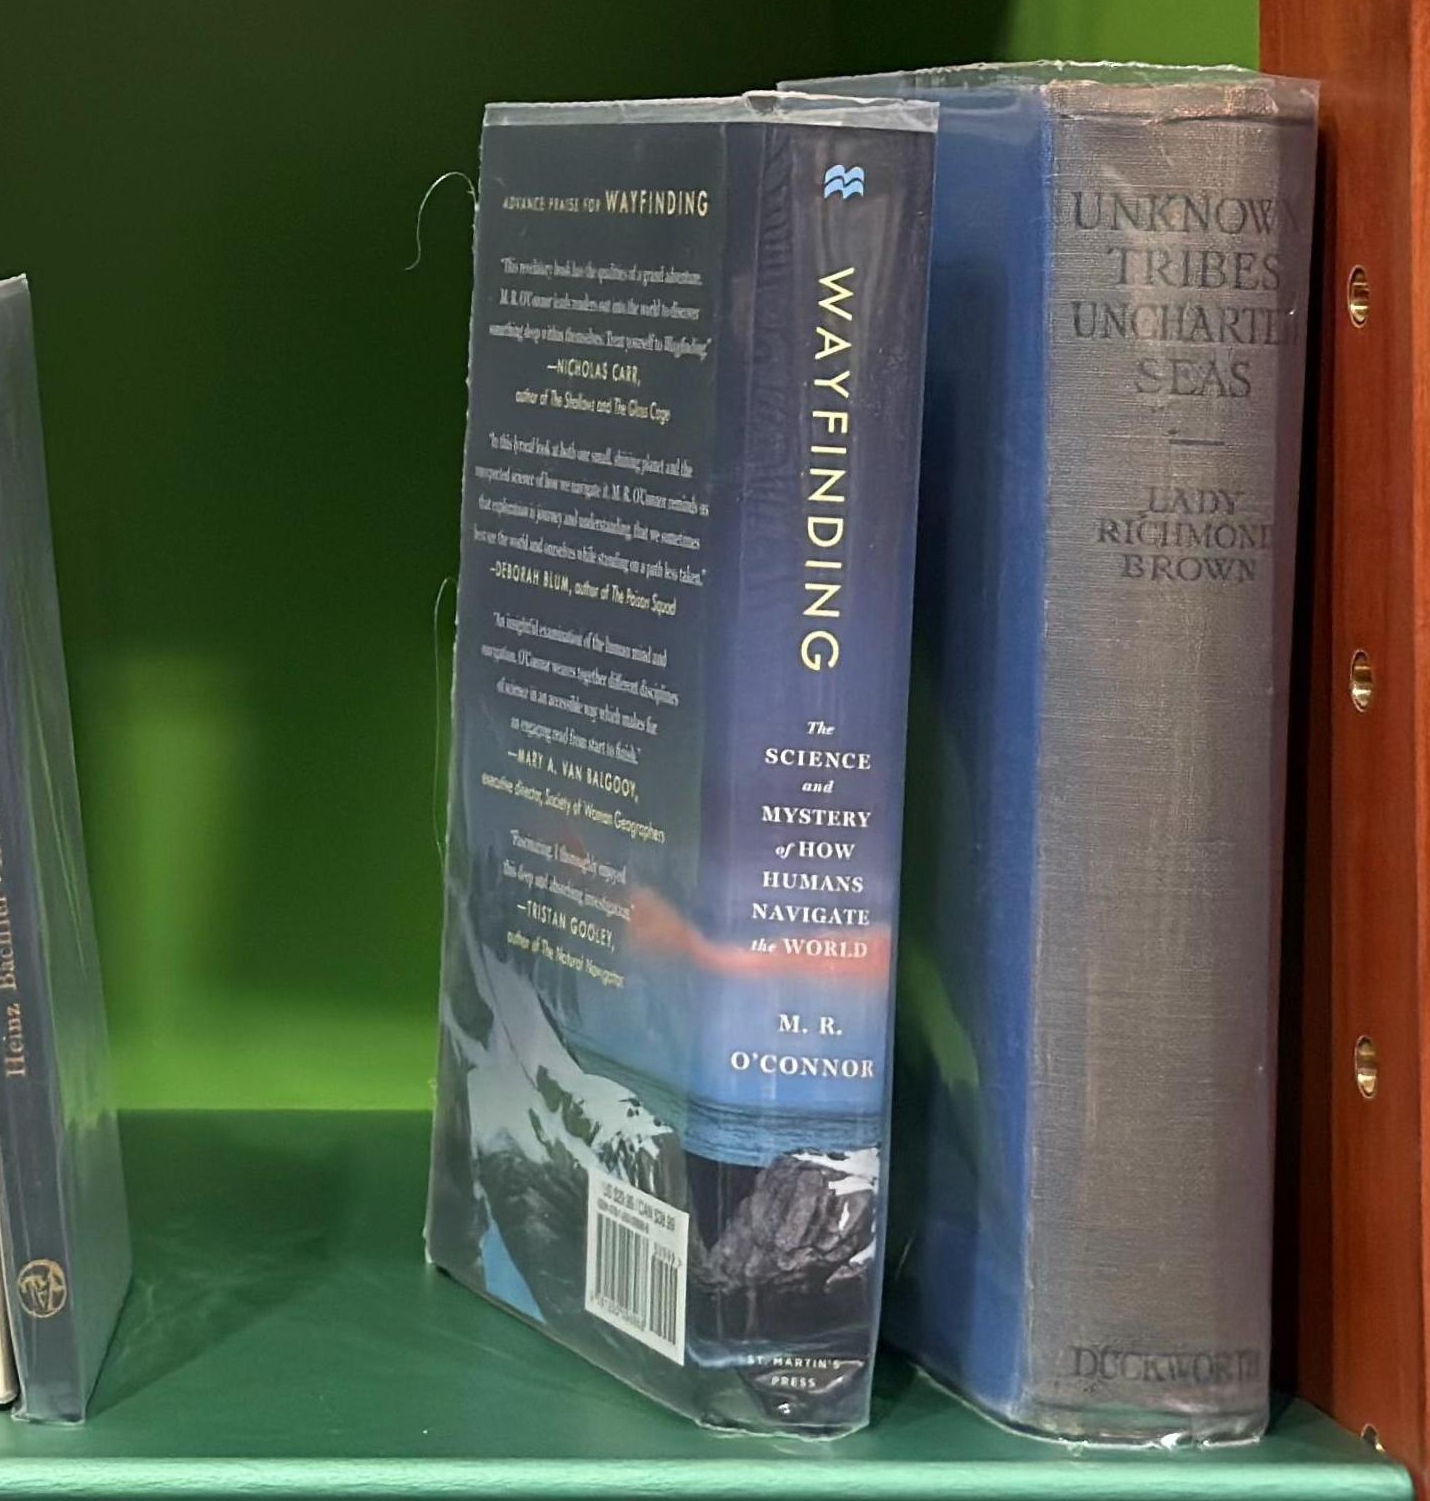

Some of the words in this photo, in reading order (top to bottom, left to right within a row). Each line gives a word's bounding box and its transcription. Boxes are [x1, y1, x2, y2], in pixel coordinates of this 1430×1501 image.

[605, 190, 708, 217] WAYFINDING
[1107, 246, 1281, 290] TRIBES
[1133, 358, 1252, 398] SEAS
[800, 267, 855, 672] WAYFINDING
[1142, 487, 1246, 516] LADY
[1121, 554, 1256, 582] BROWN
[807, 722, 835, 736] The
[765, 748, 871, 770] SCIENCE
[802, 780, 833, 794] and
[761, 806, 871, 828] MYSTERY
[775, 843, 795, 859] of
[800, 841, 855, 859] HOW
[763, 871, 864, 893] HUMANS
[751, 903, 869, 926] NAVIGATE
[751, 938, 776, 953] the
[782, 939, 867, 958] WORLD
[3, 1003, 25, 1078] Heinz
[771, 1376, 816, 1387] PRESS
